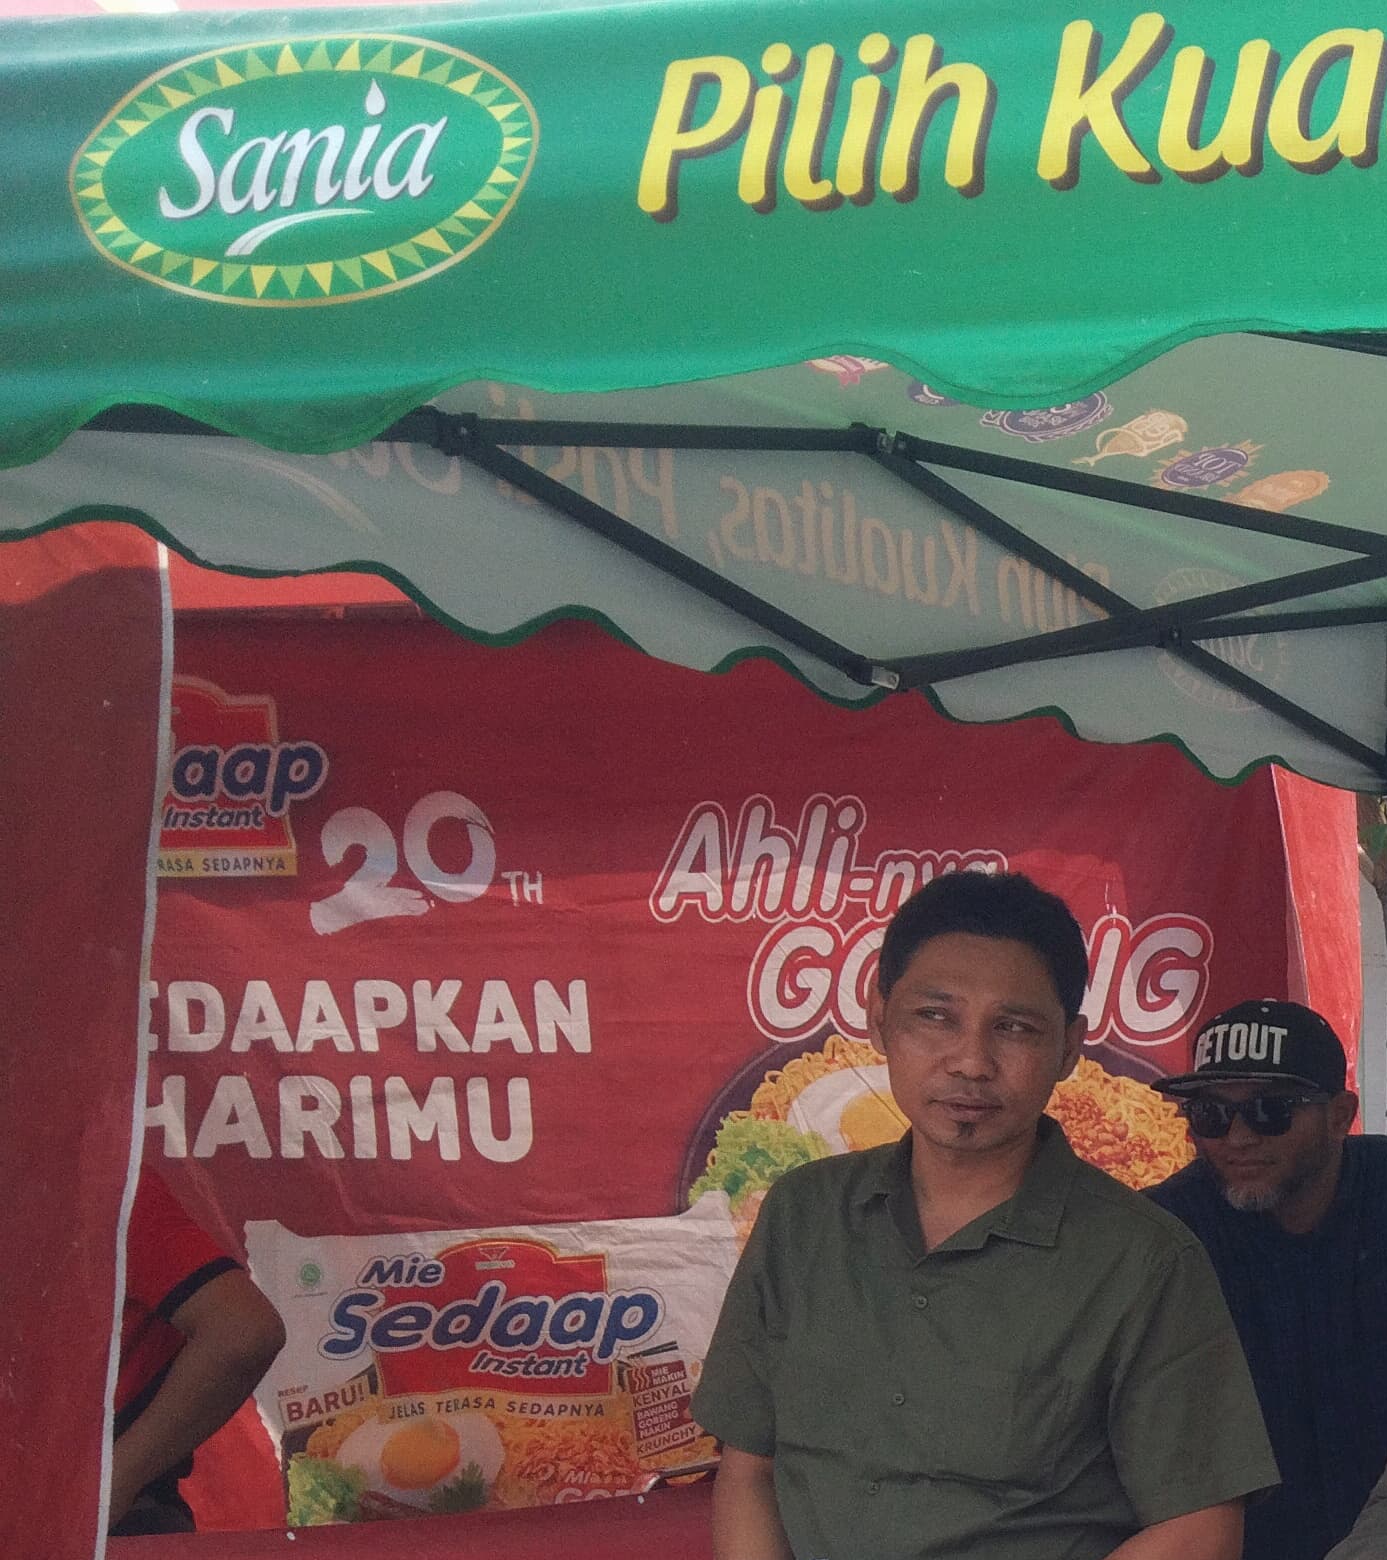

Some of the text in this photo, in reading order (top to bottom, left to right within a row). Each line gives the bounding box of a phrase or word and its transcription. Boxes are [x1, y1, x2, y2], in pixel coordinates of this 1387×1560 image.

[637, 32, 997, 220] Pilih
[158, 78, 449, 220] Sania
[165, 740, 328, 815] aap
[157, 856, 286, 874] RASA SEDAPNYA
[311, 790, 544, 936] 20 TH
[148, 979, 592, 1055] DAAPKAN
[358, 1254, 444, 1285] Mie
[320, 1282, 662, 1361] Sedaap
[469, 1351, 587, 1378] Instant
[286, 1382, 364, 1423] BARU!
[389, 1397, 606, 1420] JELAS TERASA SEDAPNYA
[633, 1381, 690, 1408] KENYAL
[638, 1425, 697, 1454] KRUNCHY
